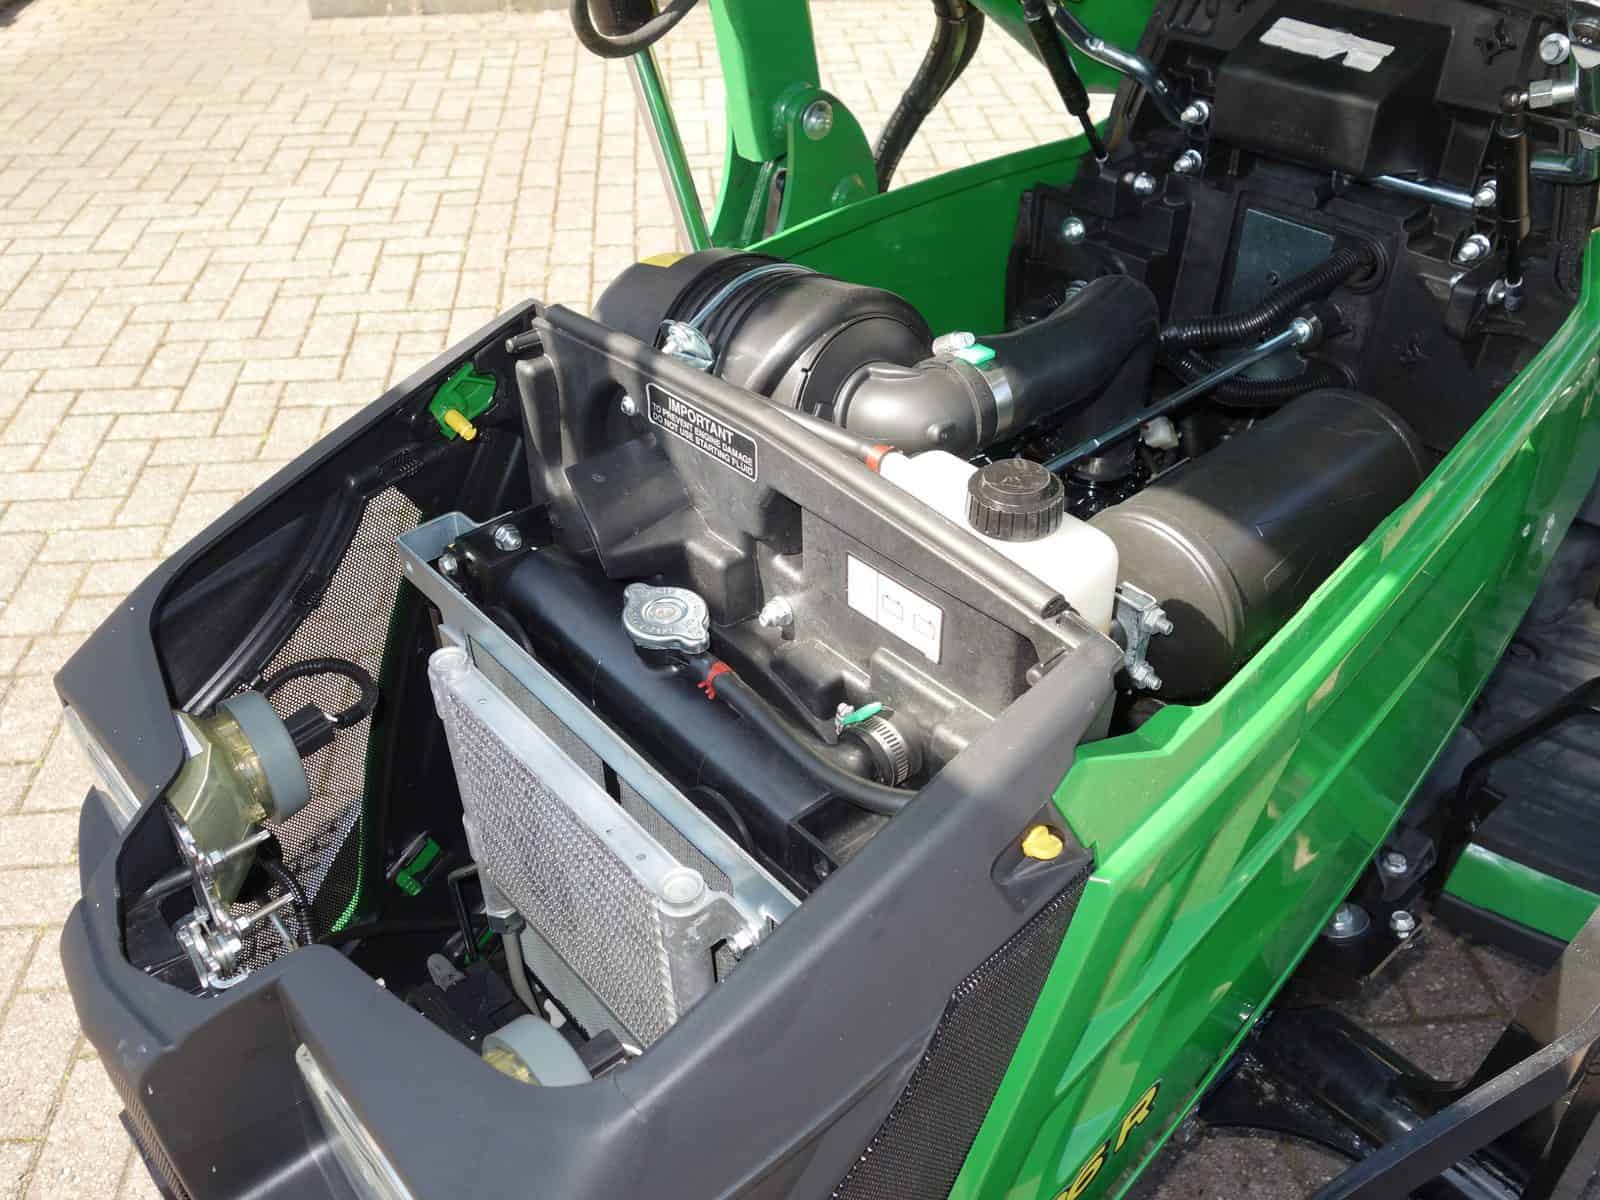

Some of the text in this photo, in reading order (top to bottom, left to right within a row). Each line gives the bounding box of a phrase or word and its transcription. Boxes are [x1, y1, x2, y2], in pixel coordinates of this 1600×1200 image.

[652, 402, 753, 466] TO PREVENT ENGINE DAMAGE
[653, 412, 753, 476] DO NOT USE STARTING FLUID
[668, 397, 734, 444] IMPORTANT
